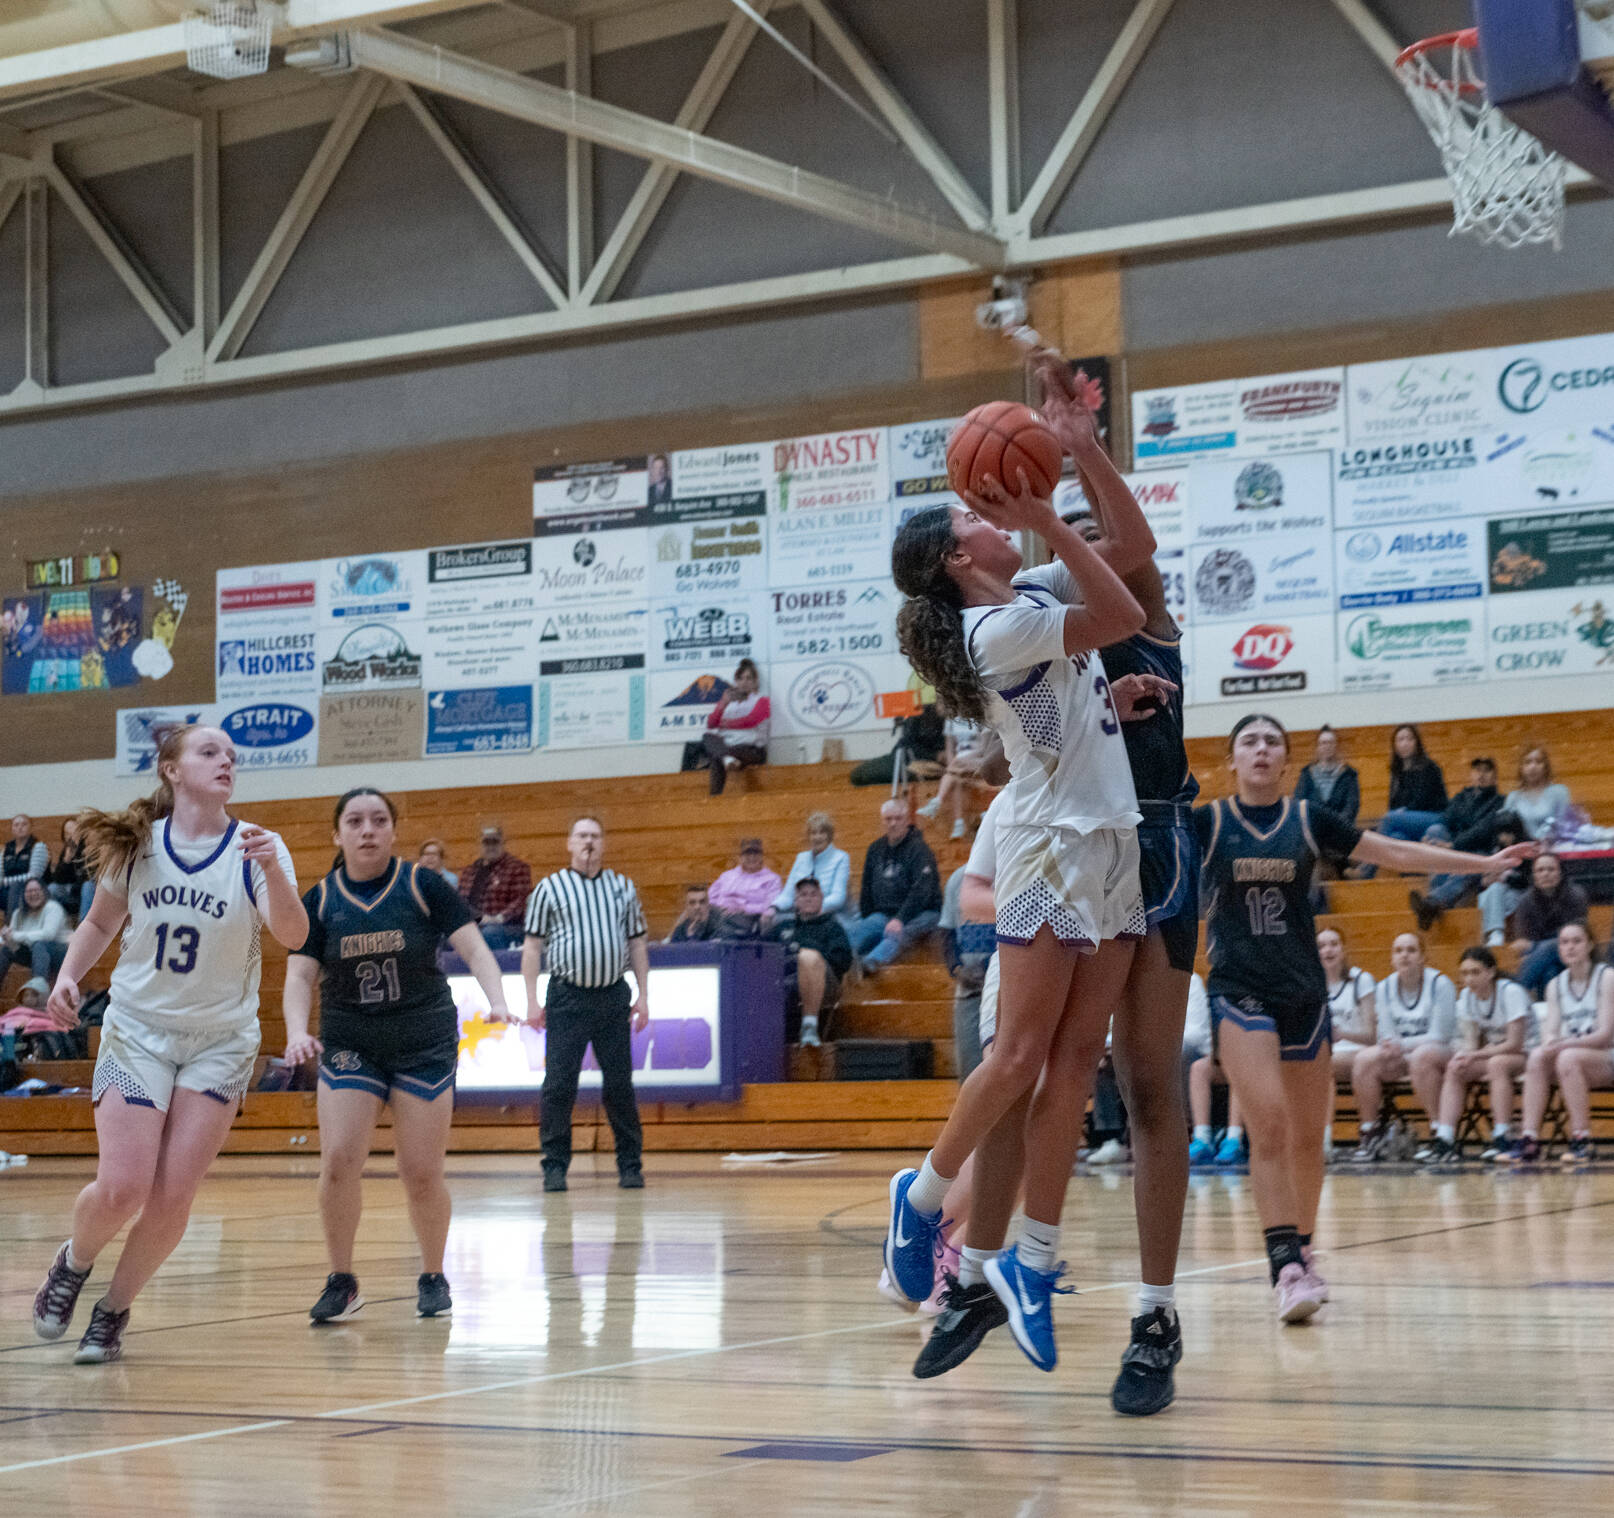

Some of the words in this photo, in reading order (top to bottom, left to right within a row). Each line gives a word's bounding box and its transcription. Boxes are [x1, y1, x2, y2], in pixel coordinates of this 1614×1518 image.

[773, 432, 880, 473] DYNASTY
[1341, 437, 1475, 467] LONGHOUSE
[1387, 530, 1468, 555] Allstate
[538, 566, 587, 591] Moon
[593, 555, 645, 585] Palace
[675, 560, 740, 578] 683-4970
[771, 589, 848, 613] TORRES
[666, 613, 749, 641] WEBB
[1492, 621, 1570, 643] GREEN
[247, 632, 316, 651] HILLCREST
[797, 634, 883, 655] 582-1500
[1241, 633, 1286, 662] DQ
[247, 652, 316, 677] HOMES
[325, 665, 367, 682] Wood
[371, 661, 420, 680] Works
[1496, 650, 1567, 672] CROW
[231, 708, 303, 730] STRAIT
[142, 884, 229, 920] WOLVES
[1245, 886, 1288, 936] 12
[155, 922, 201, 975] 13
[354, 957, 401, 1004] 21
